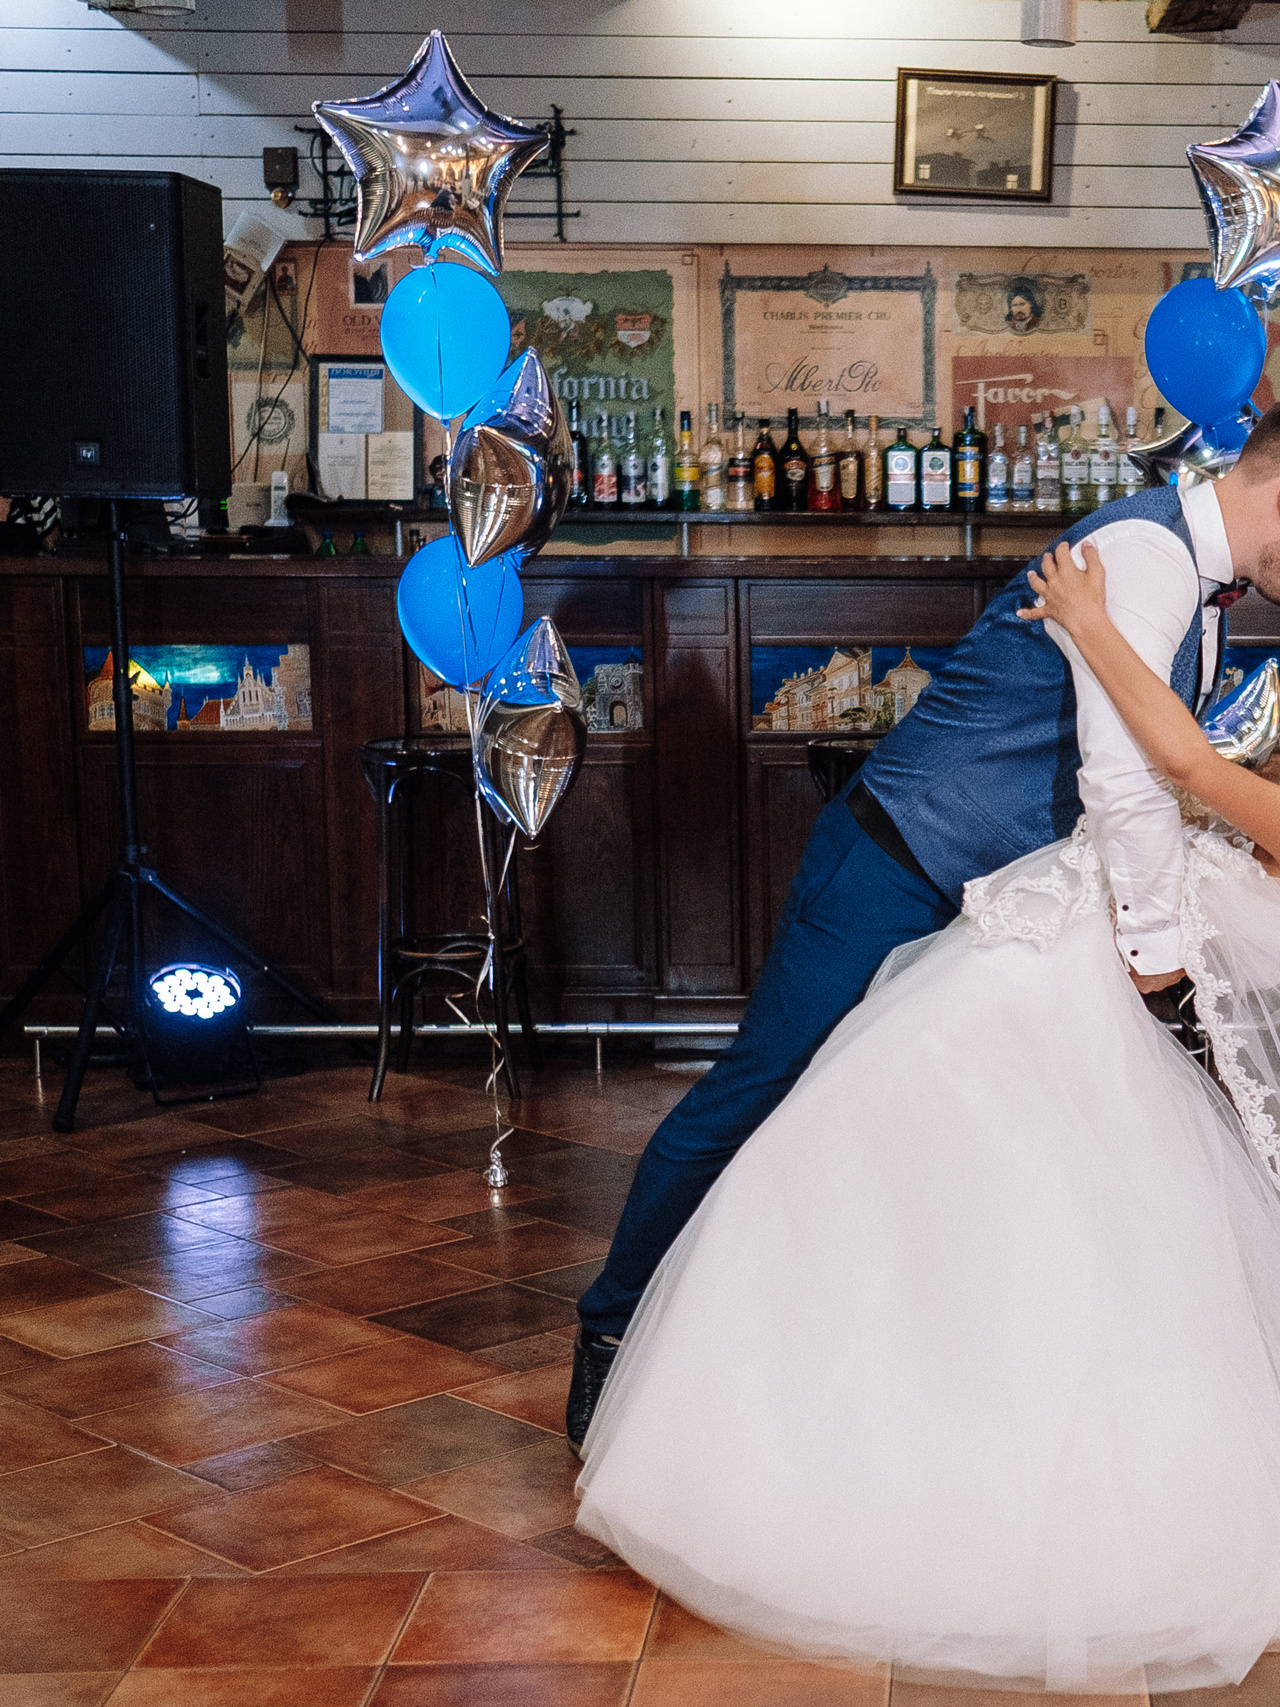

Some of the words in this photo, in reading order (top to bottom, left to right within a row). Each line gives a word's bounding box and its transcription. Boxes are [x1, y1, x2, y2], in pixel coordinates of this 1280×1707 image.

[763, 310, 809, 321] CHABLIS
[814, 310, 863, 321] PREMIER
[867, 310, 892, 321] CRU
[553, 366, 650, 401] fornia
